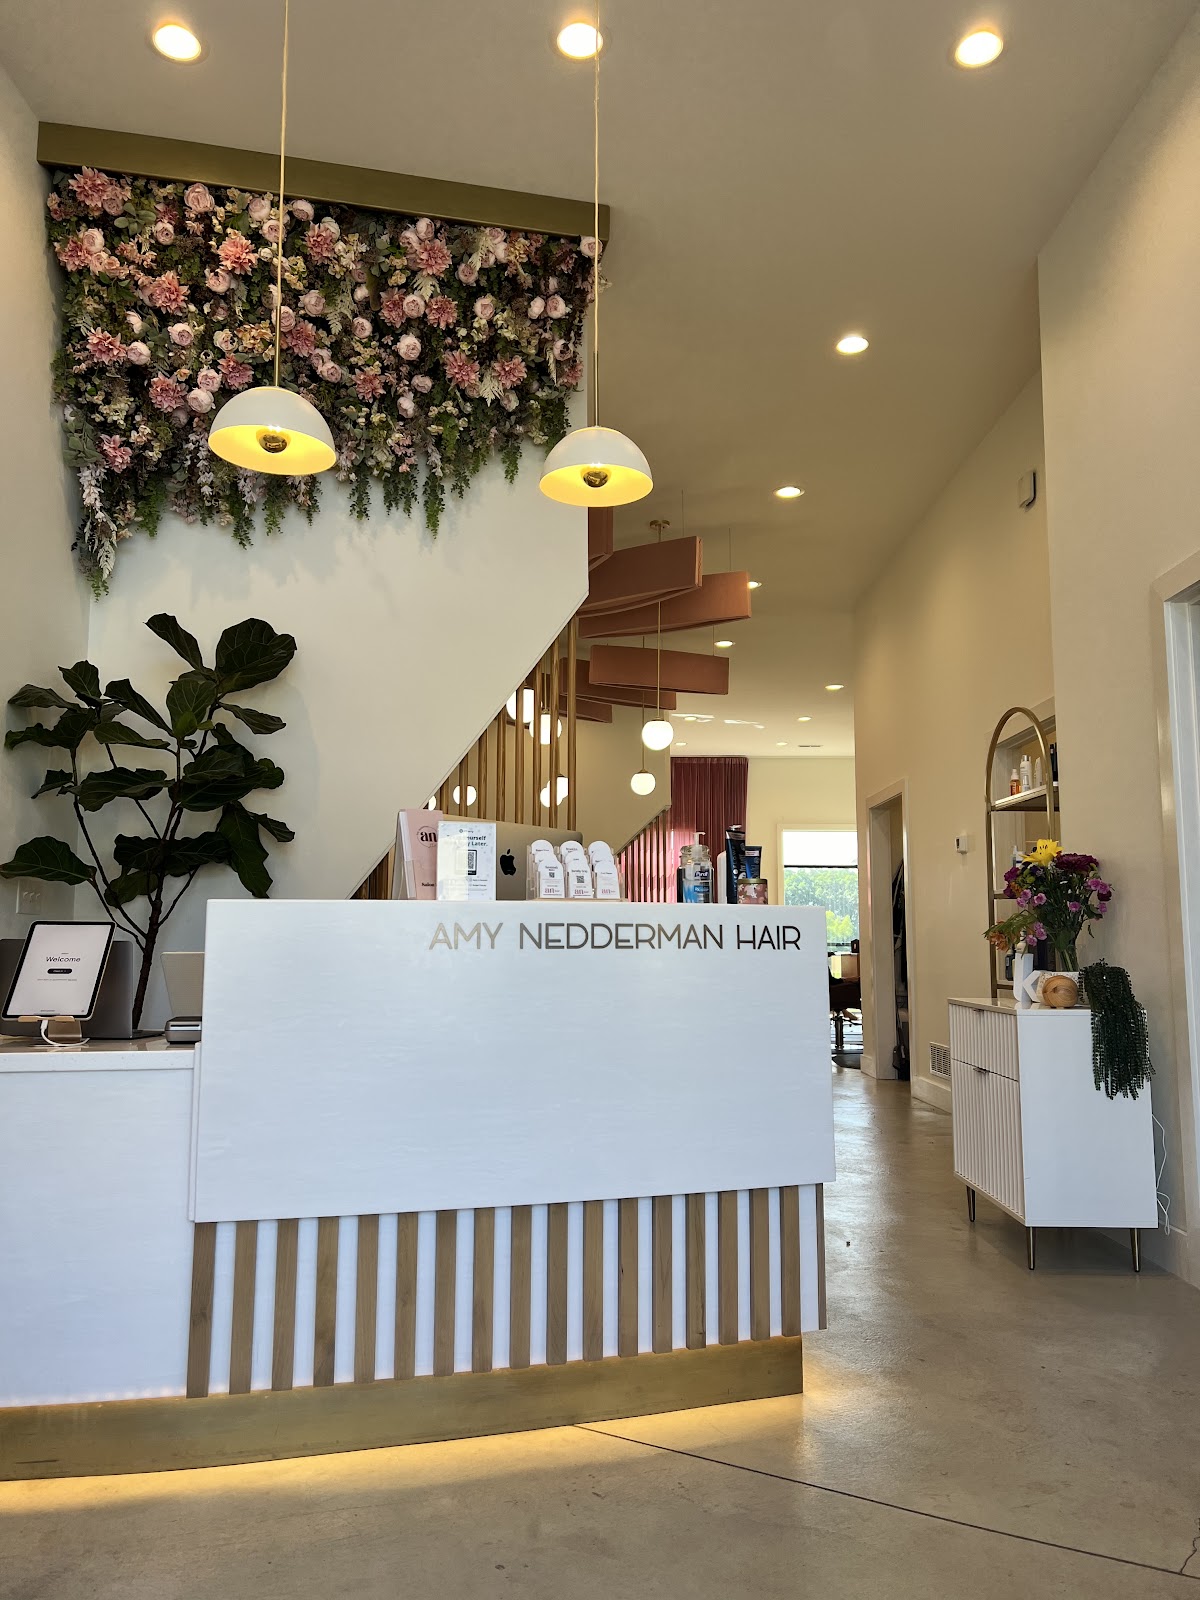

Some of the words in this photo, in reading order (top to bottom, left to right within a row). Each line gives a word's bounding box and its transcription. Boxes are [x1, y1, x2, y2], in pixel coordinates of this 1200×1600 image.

[429, 922, 503, 950] AMY
[519, 922, 723, 950] NEDDERMAN
[736, 924, 801, 951] HAIR
